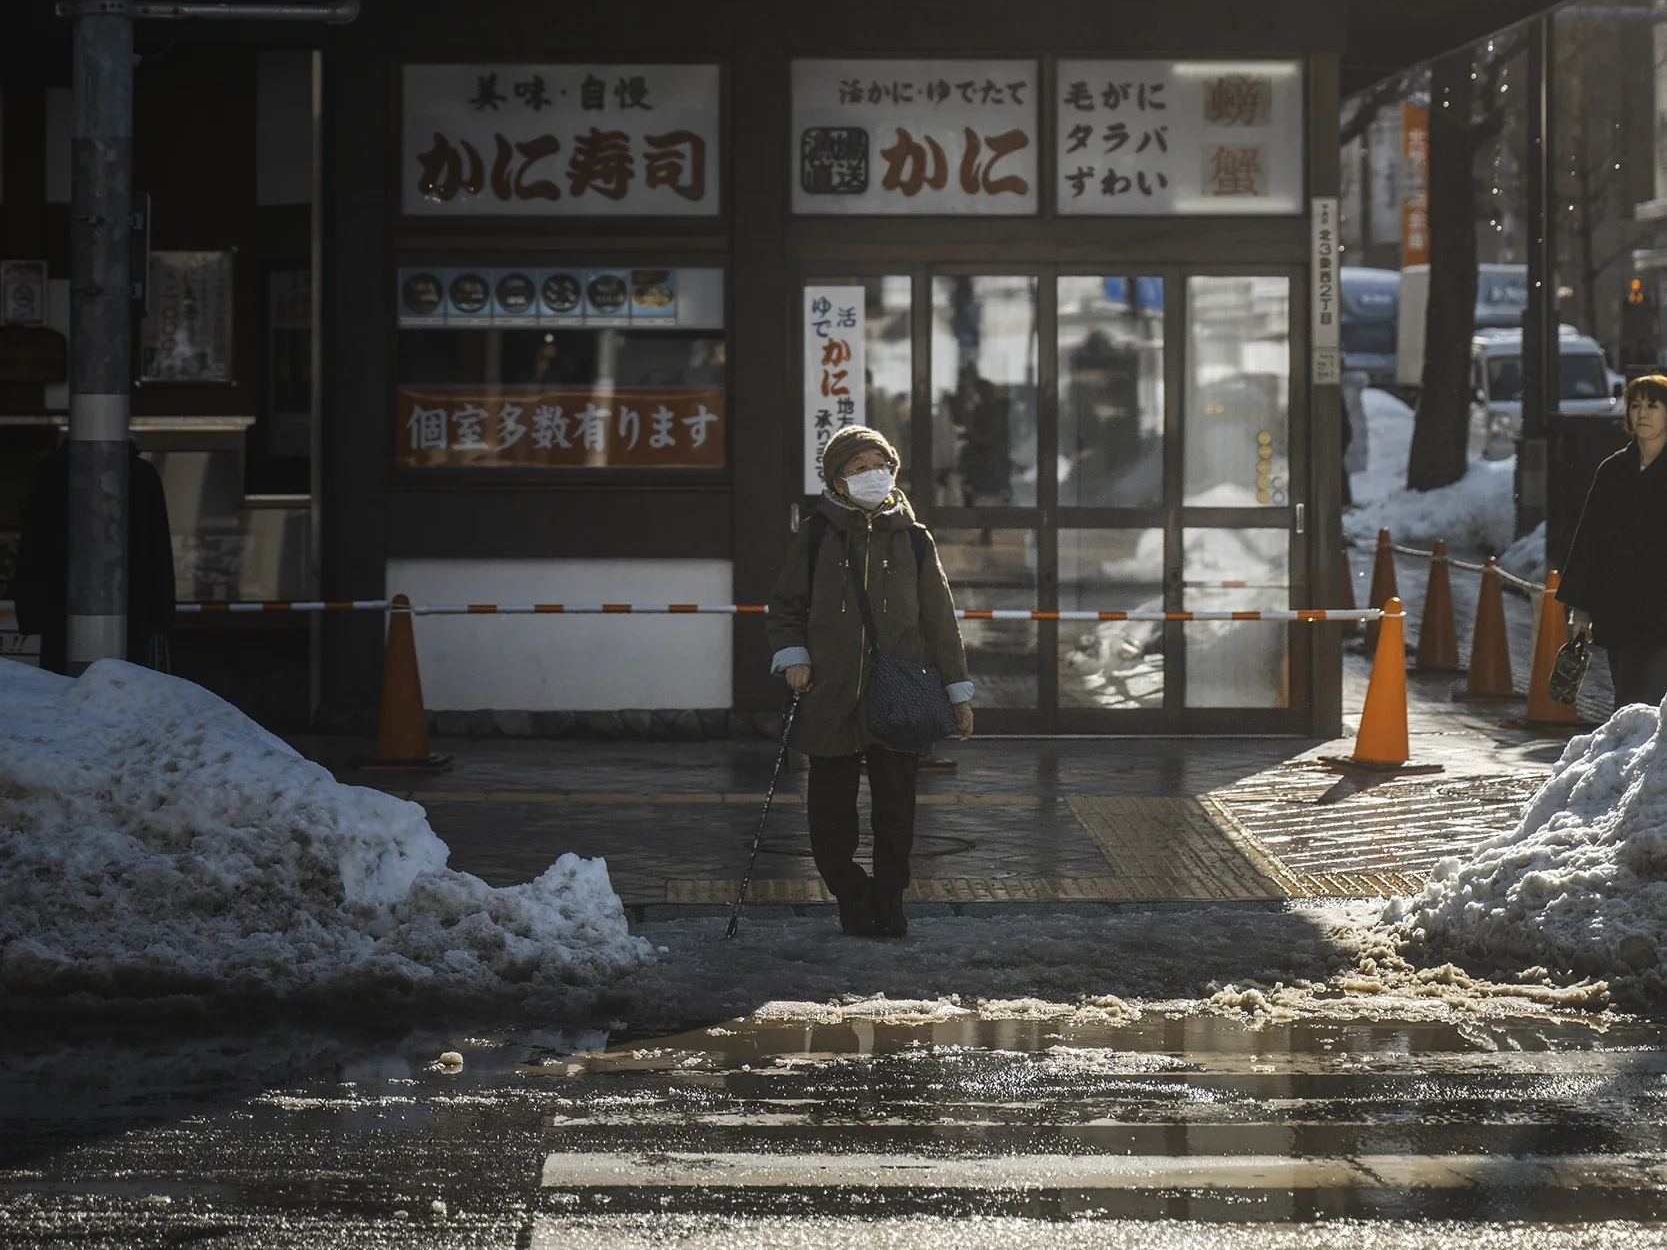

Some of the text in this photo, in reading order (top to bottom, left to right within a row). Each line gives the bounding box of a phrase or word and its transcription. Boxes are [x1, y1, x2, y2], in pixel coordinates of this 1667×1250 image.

[1064, 81, 1167, 111] 毛がに
[1066, 121, 1168, 154] タラバ
[416, 126, 706, 202] かに寿司
[879, 126, 1030, 197] かに
[1065, 166, 1169, 198] ずわい
[811, 296, 832, 338] ゆで
[836, 306, 856, 328] 活
[821, 338, 852, 398] かに
[407, 403, 719, 451] 個室多数有ります
